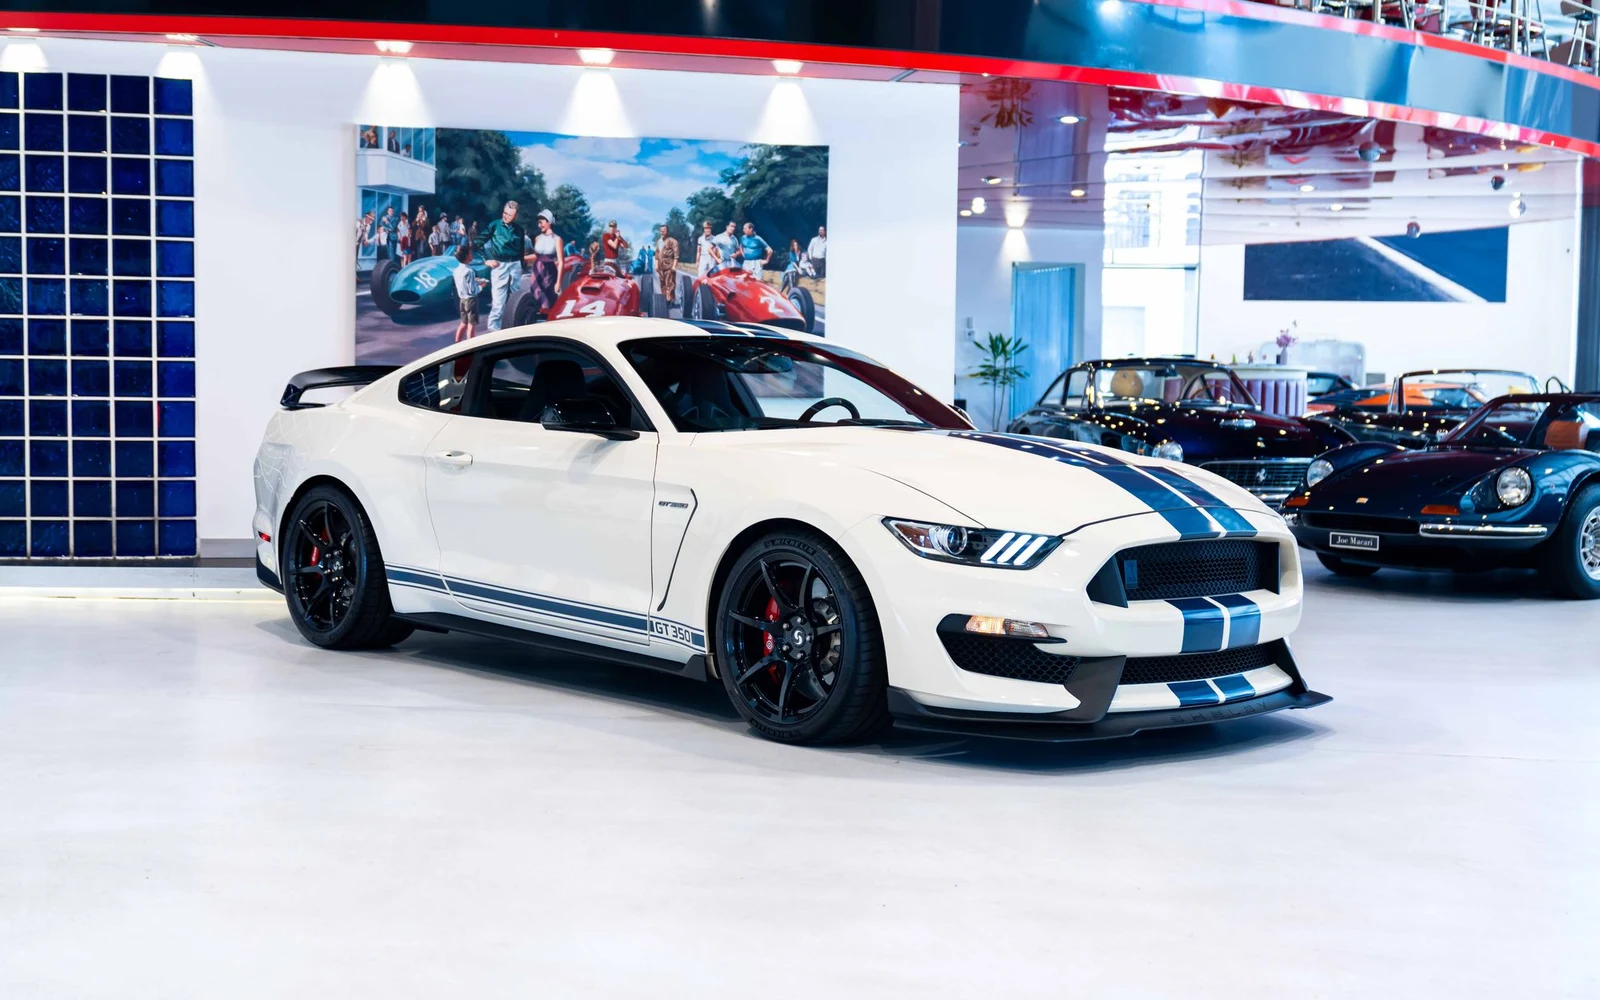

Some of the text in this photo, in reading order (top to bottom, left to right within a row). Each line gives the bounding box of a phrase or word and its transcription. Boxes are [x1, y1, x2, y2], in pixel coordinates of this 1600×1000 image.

[413, 272, 438, 290] 18
[556, 299, 607, 319] 14
[759, 296, 785, 314] 2
[774, 538, 814, 554] MICHELIN
[1336, 535, 1373, 546] Joe Macari
[655, 621, 691, 643] GT 350
